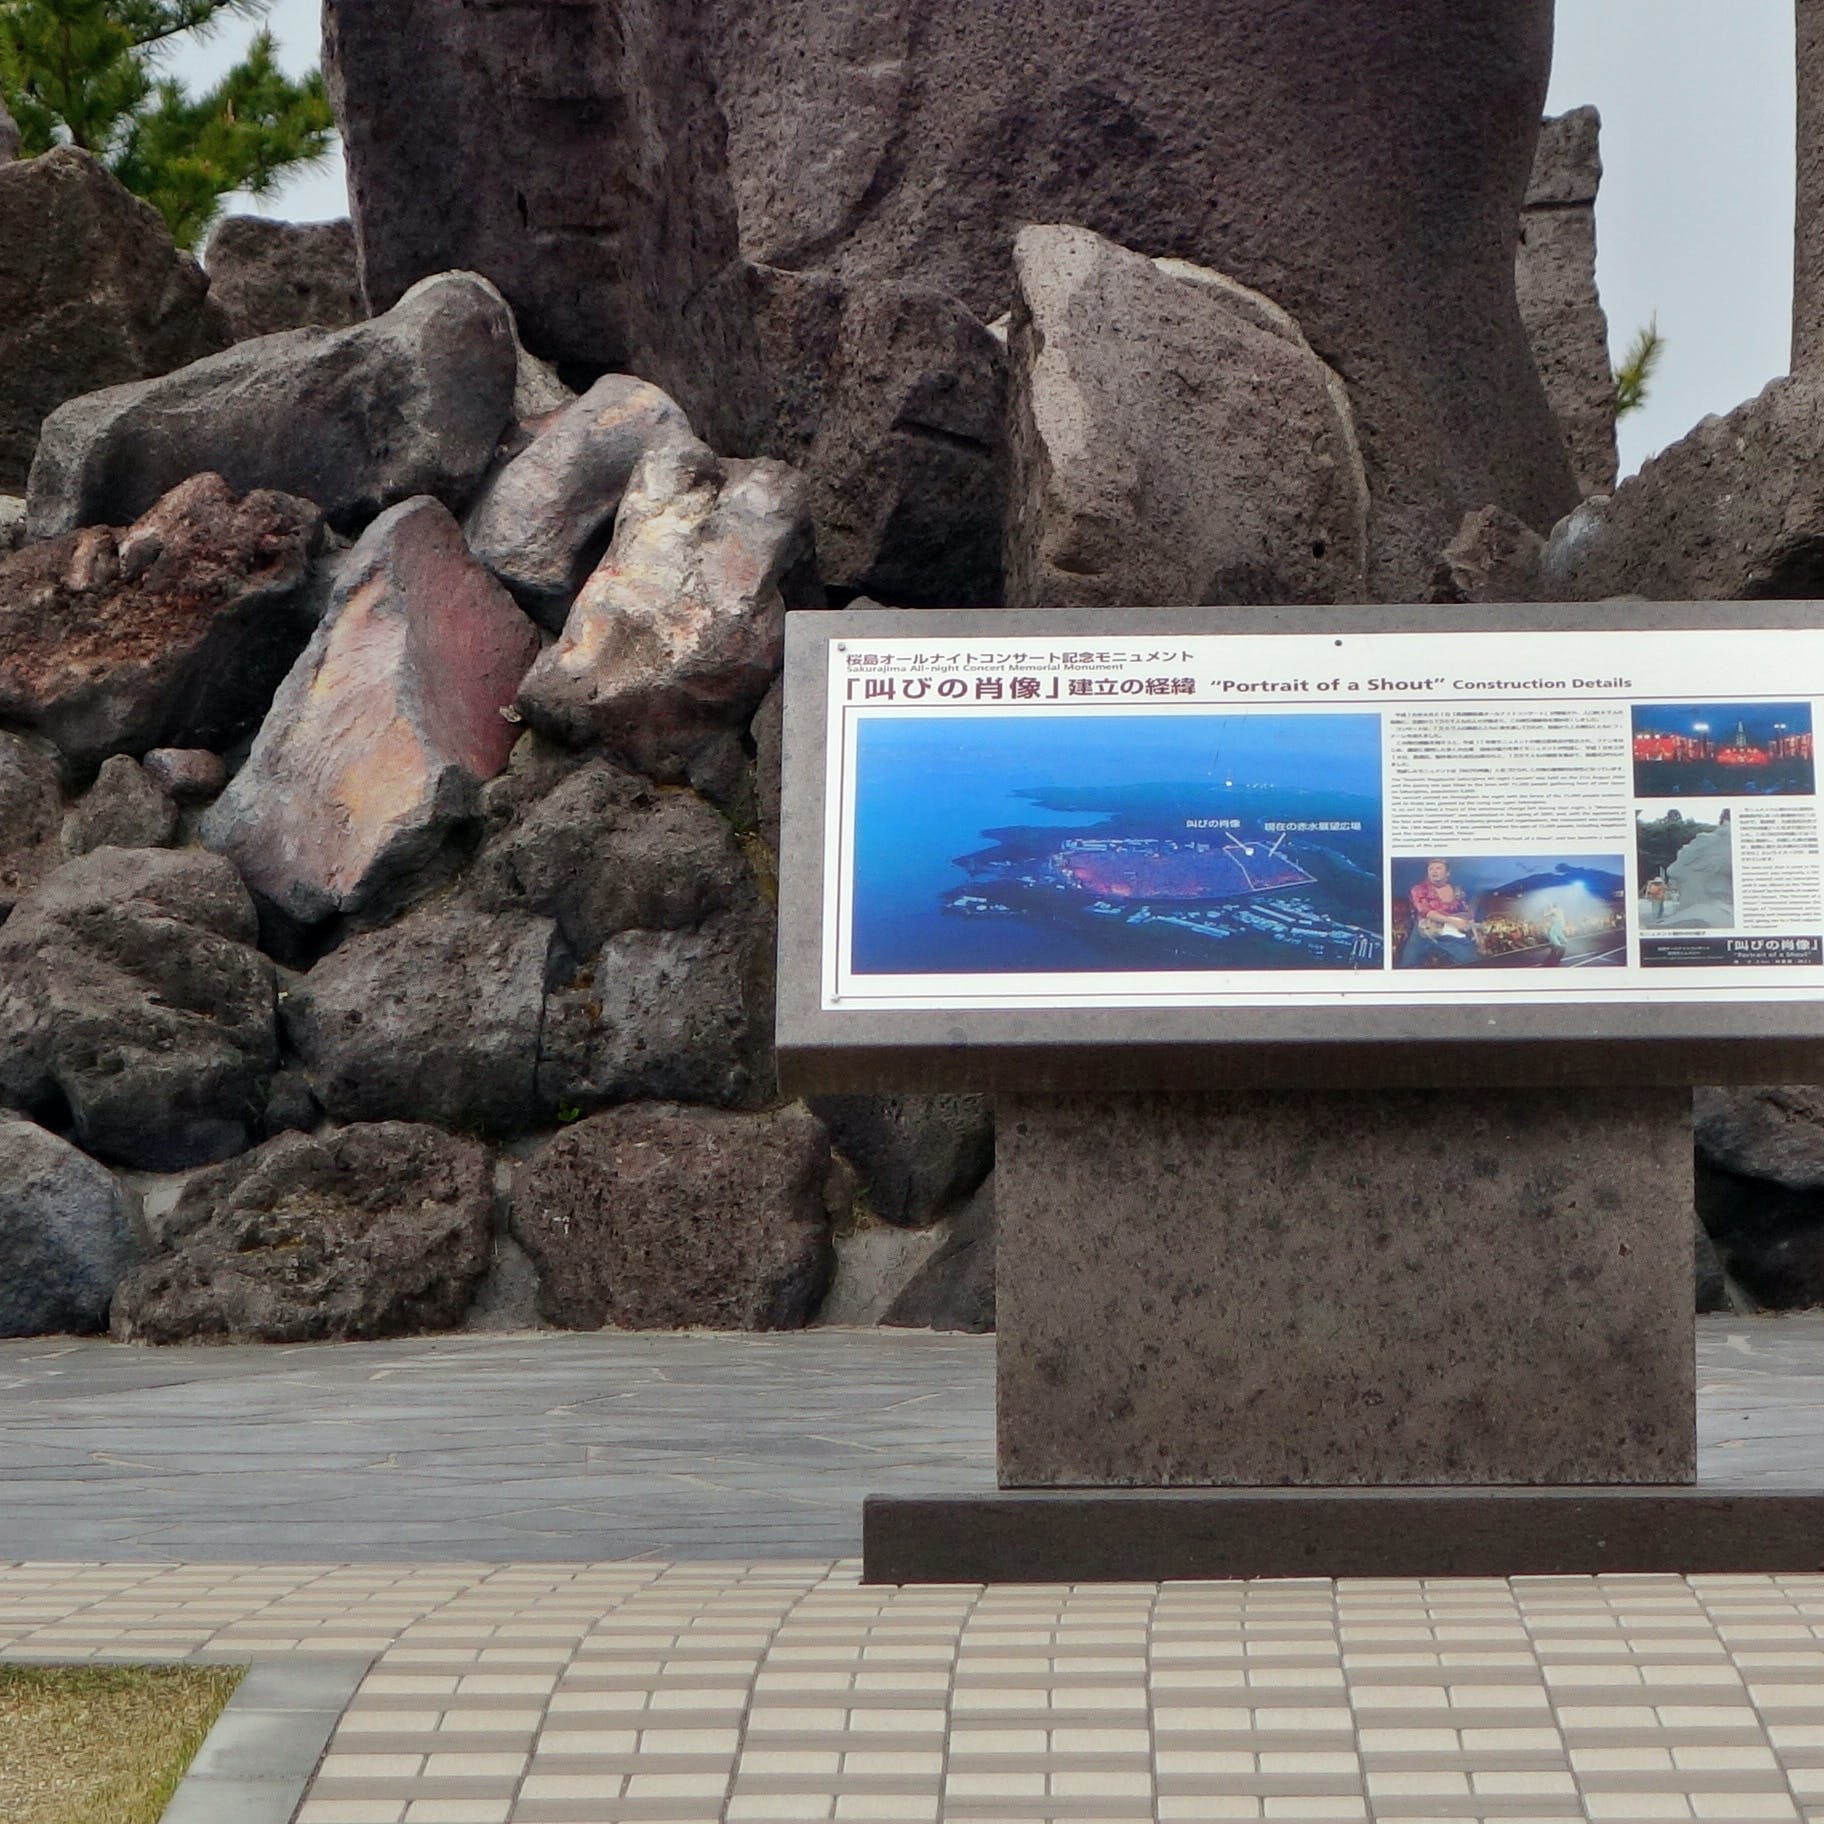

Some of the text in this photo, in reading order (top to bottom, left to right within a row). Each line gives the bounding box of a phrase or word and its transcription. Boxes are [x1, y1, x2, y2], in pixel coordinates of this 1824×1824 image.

[846, 651, 1194, 665] 桜島オールナイトコンサート記念モニュメント
[846, 665, 907, 673] Sakurajima
[963, 663, 1006, 672] Concert
[1009, 663, 1060, 671] Memorial
[1064, 663, 1123, 671] Monument
[1317, 679, 1341, 692] of
[1348, 682, 1359, 691] a
[1452, 679, 1566, 690] Construction
[1572, 678, 1632, 689] Details
